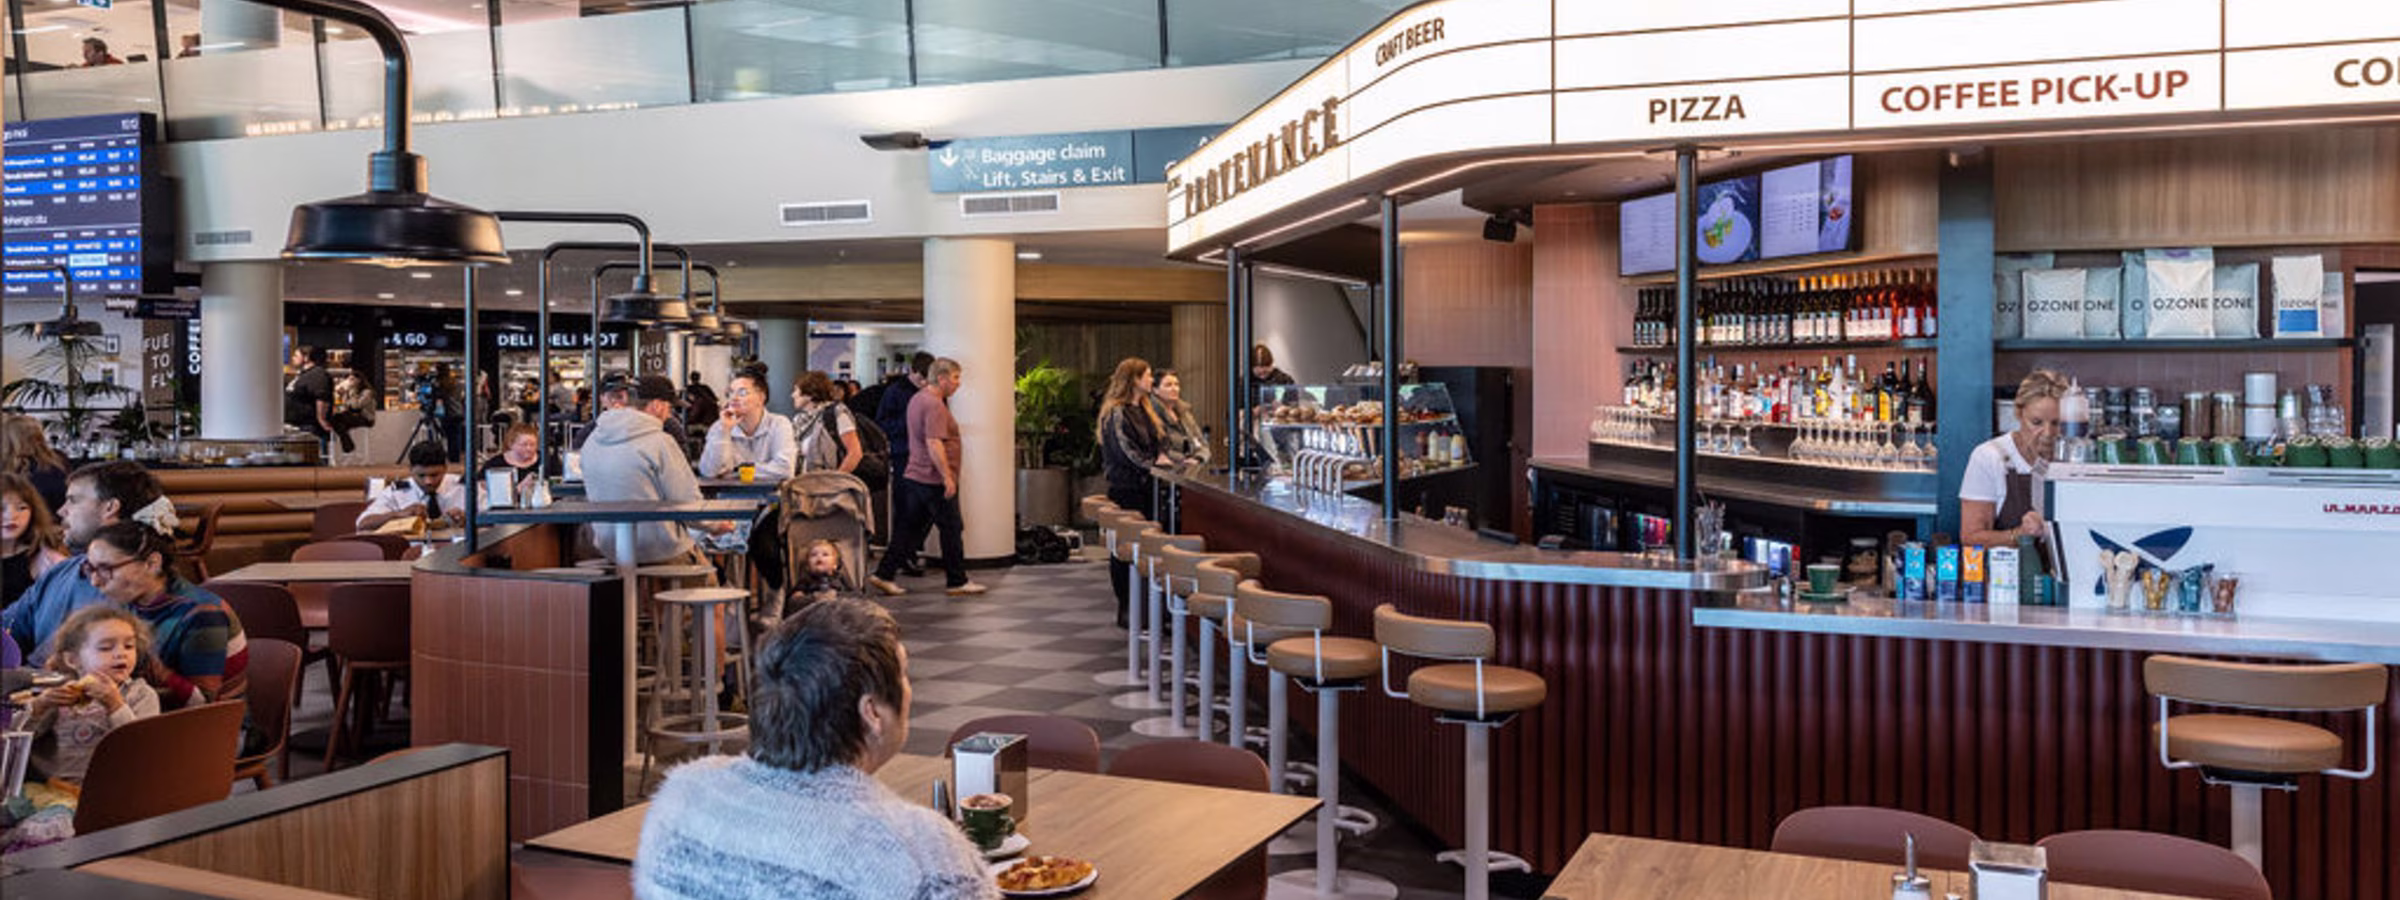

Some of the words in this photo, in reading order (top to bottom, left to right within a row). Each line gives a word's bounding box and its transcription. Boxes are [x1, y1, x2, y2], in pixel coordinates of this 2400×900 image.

[1376, 31, 1404, 67] CRAFT
[1406, 17, 1445, 50] BEER
[2334, 56, 2400, 88] CO
[1880, 80, 2020, 113] COFFEE
[2031, 69, 2189, 105] PICK-UP
[1648, 94, 1746, 123] PIZZA
[981, 148, 1057, 166] Baggage
[1060, 143, 1106, 160] claim
[1185, 96, 1340, 219] PROVENANCE
[983, 170, 1018, 188] Lift,
[1021, 168, 1068, 186] Stairs
[1072, 167, 1086, 184] &
[1091, 165, 1126, 183] Exit
[2027, 299, 2080, 313] OZONE
[2084, 299, 2115, 312] ONE
[2153, 297, 2208, 311] OZONE
[2280, 299, 2318, 308] OZONE
[405, 333, 427, 346] GO
[497, 333, 533, 346] DELI
[548, 333, 577, 346] ELI
[152, 353, 170, 369] TO
[646, 359, 662, 370] TO
[151, 369, 175, 388] FLY
